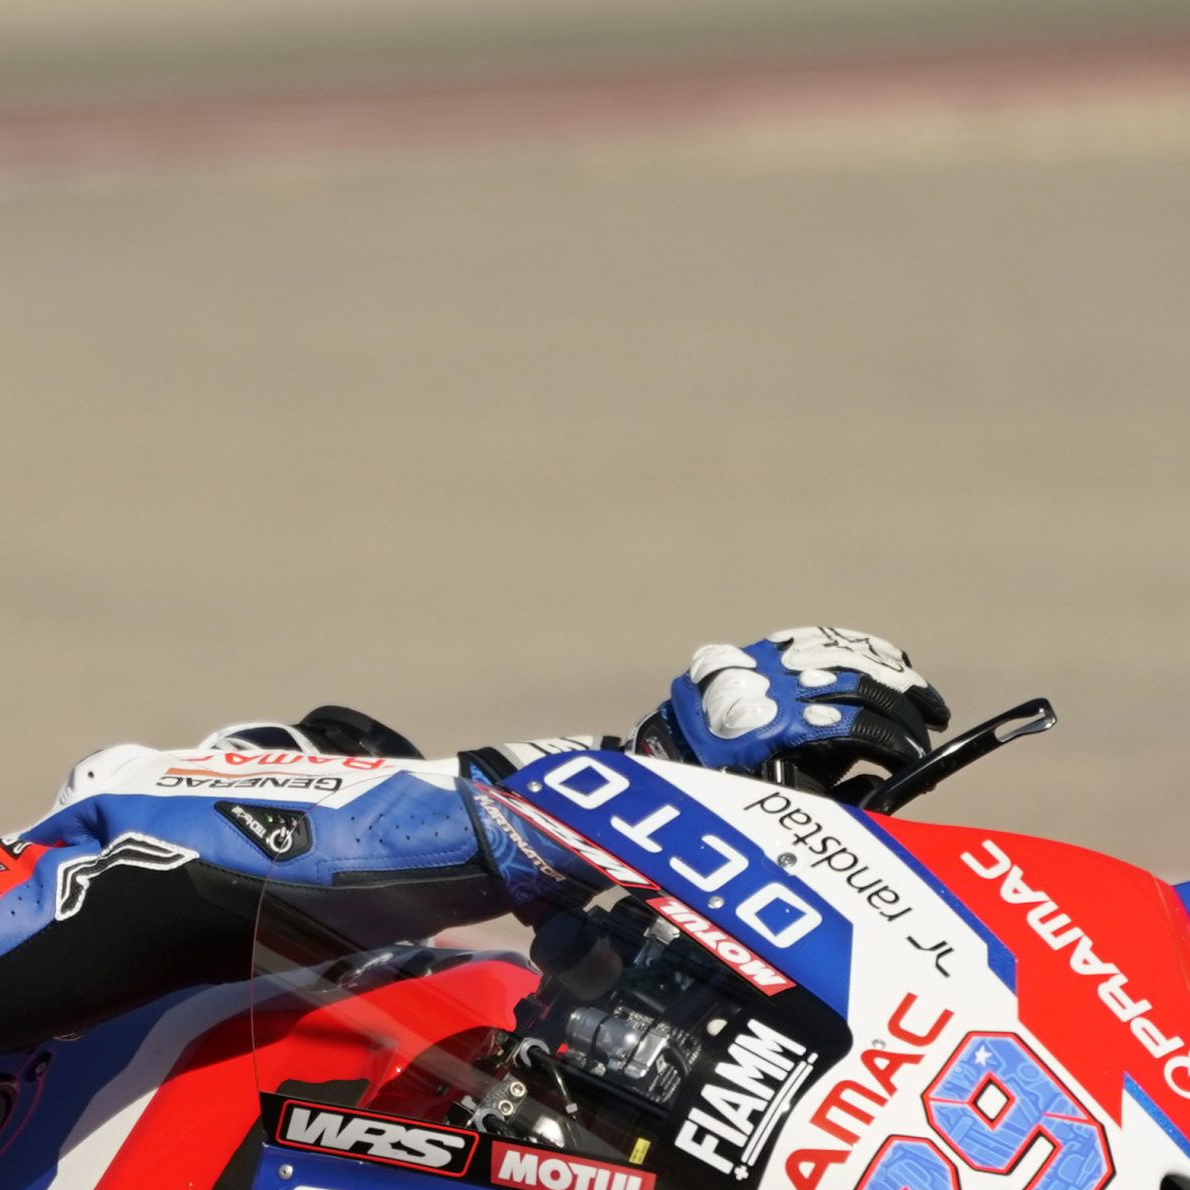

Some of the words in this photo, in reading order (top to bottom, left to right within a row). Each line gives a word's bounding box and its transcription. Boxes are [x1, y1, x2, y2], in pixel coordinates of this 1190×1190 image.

[156, 776, 344, 791] GENERAC
[544, 755, 822, 950] OCTO
[744, 791, 914, 923] randstad
[659, 900, 788, 986] MOTUL
[960, 838, 1185, 1060] PRAMAC
[285, 1107, 466, 1169] WRS
[675, 1019, 808, 1174] FIAMM
